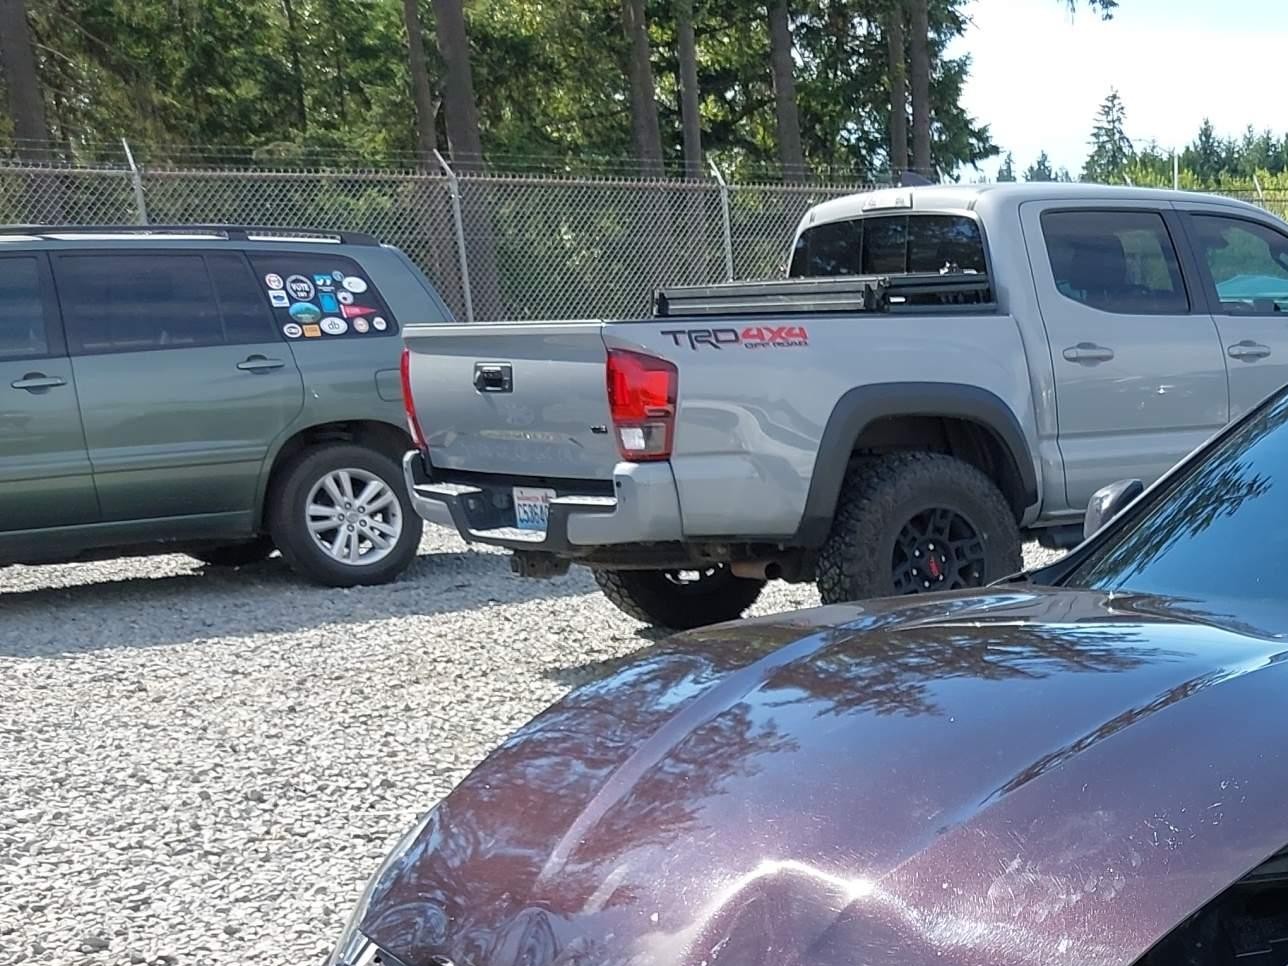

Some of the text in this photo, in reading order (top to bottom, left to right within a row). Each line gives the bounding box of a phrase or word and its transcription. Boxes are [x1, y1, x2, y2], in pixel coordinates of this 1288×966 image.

[660, 328, 739, 350] TRD
[744, 340, 808, 349] OFF ROAD
